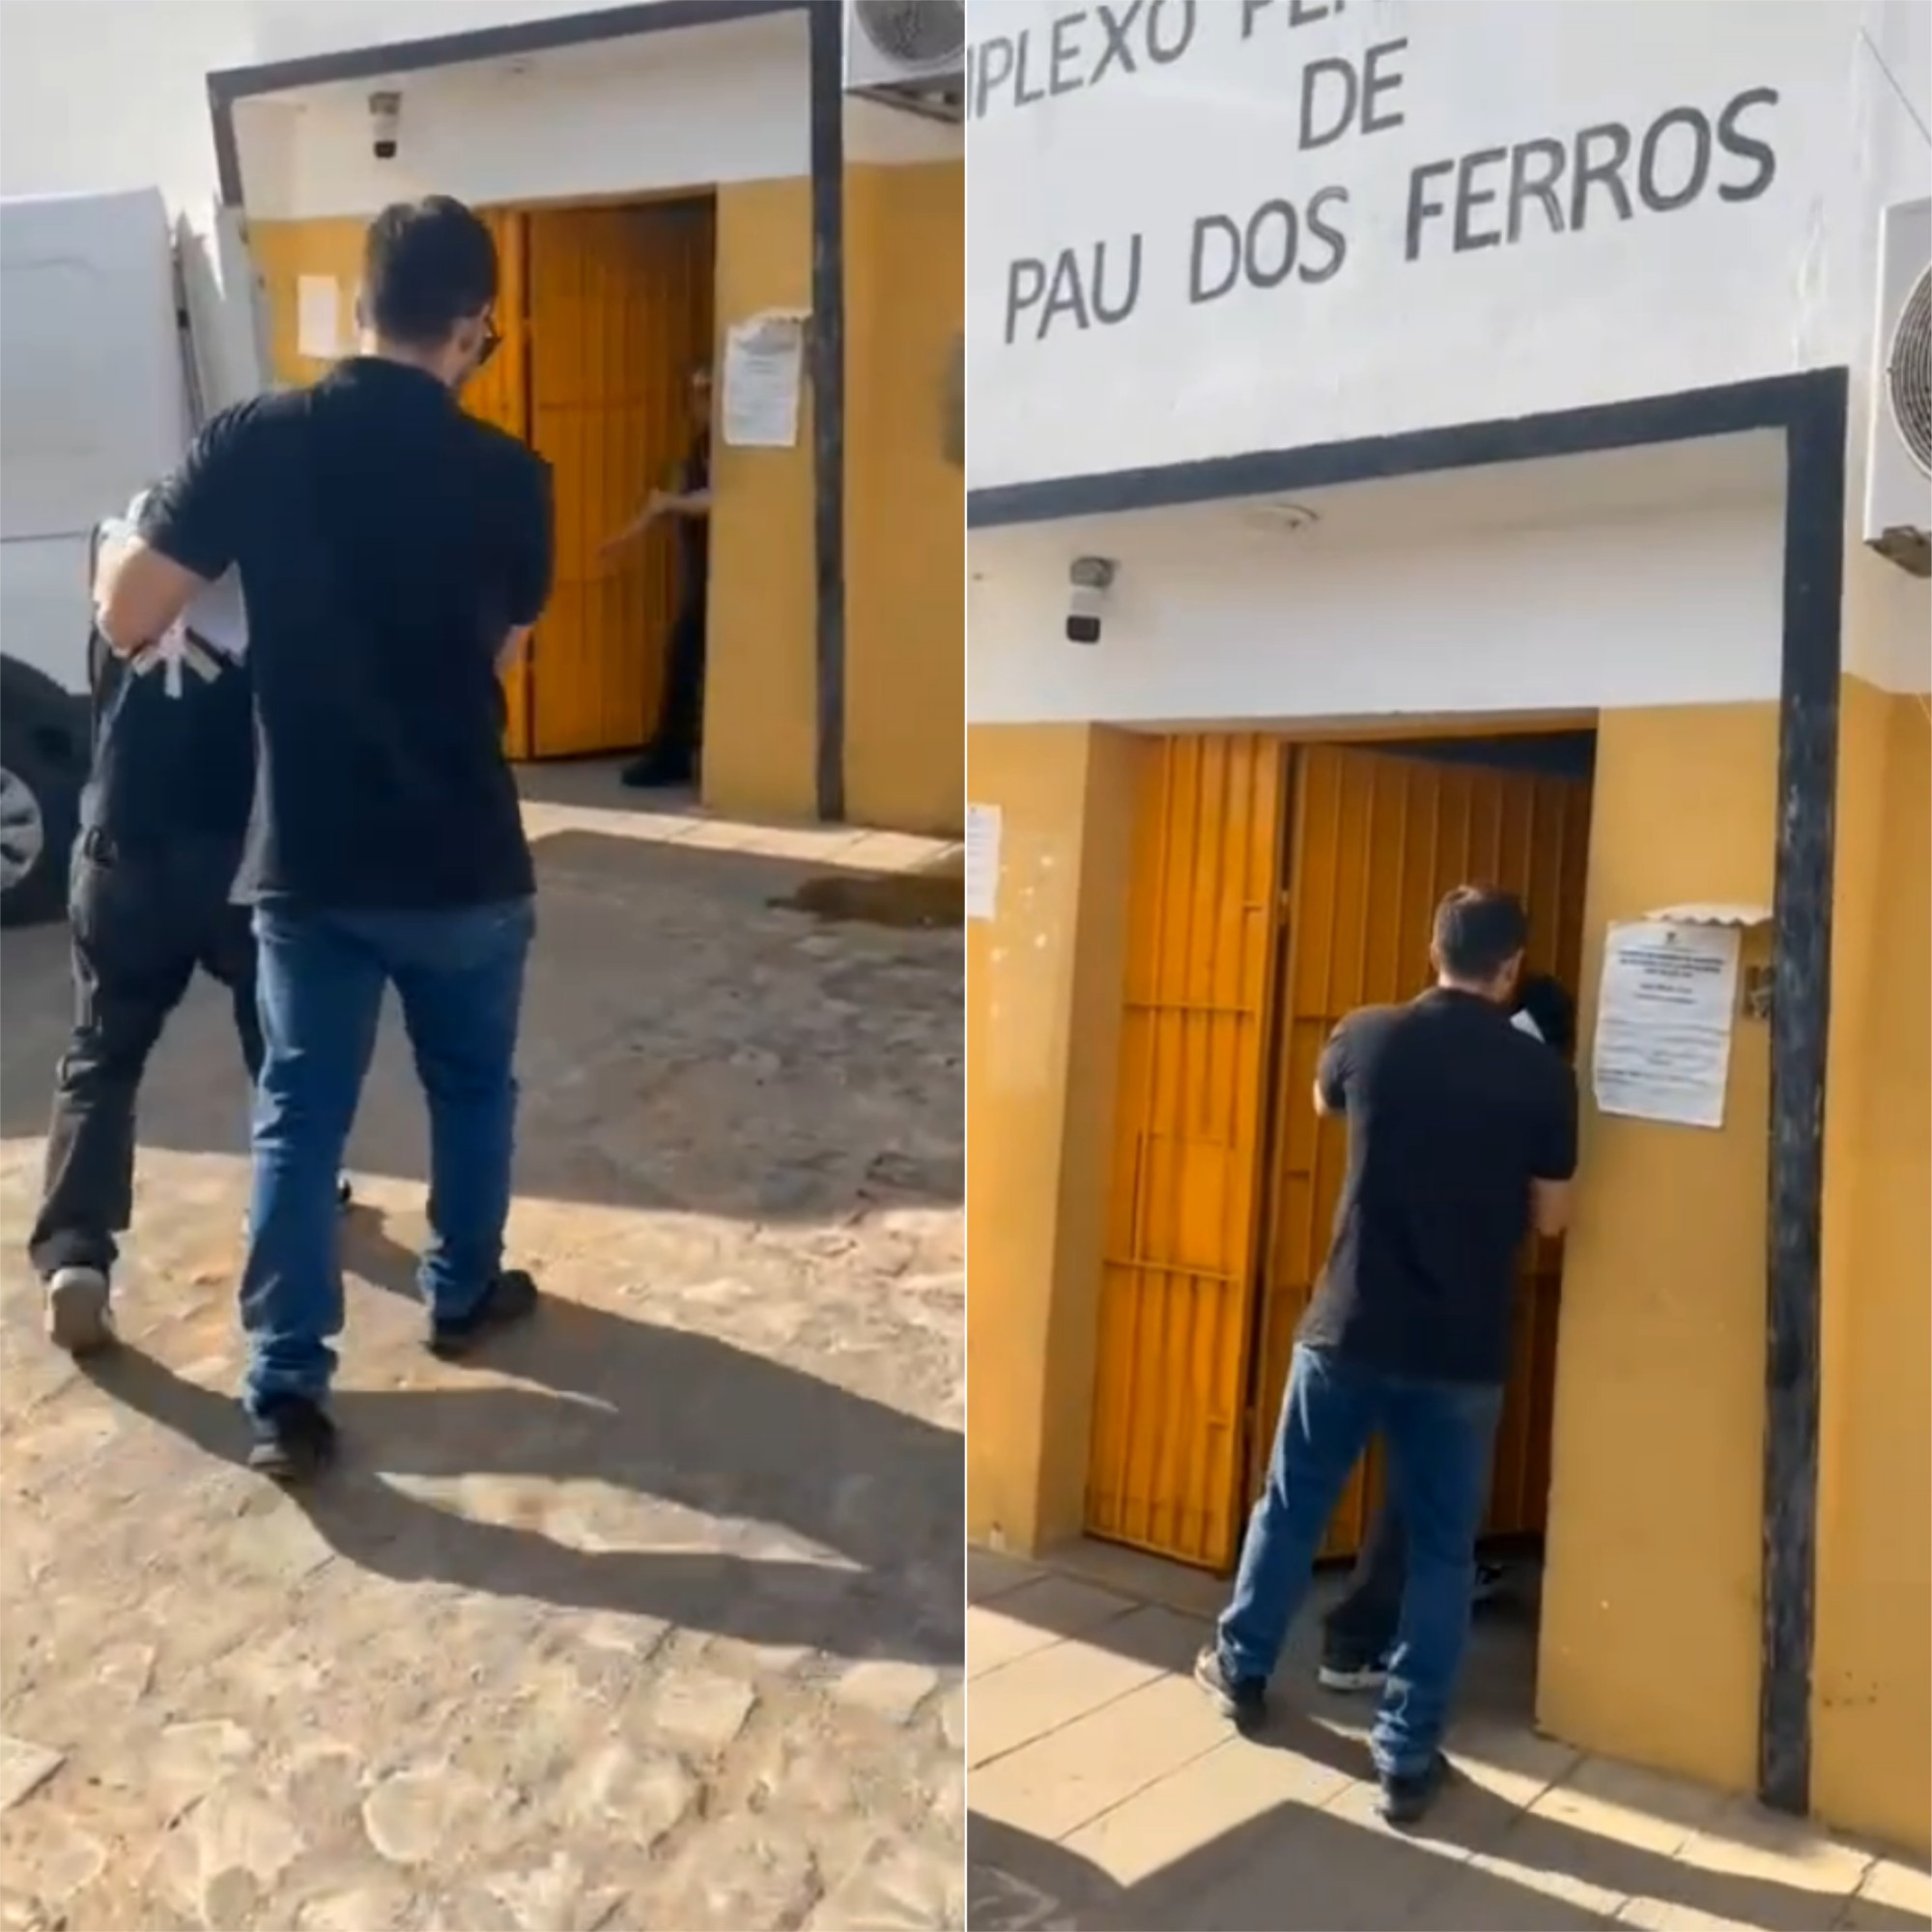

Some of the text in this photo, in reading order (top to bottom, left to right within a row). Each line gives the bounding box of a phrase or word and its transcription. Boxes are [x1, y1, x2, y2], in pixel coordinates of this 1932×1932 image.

[967, 0, 1196, 122] PLEXO
[1298, 37, 1408, 151] DE
[1006, 86, 1779, 344] PAU DOS FERROS
